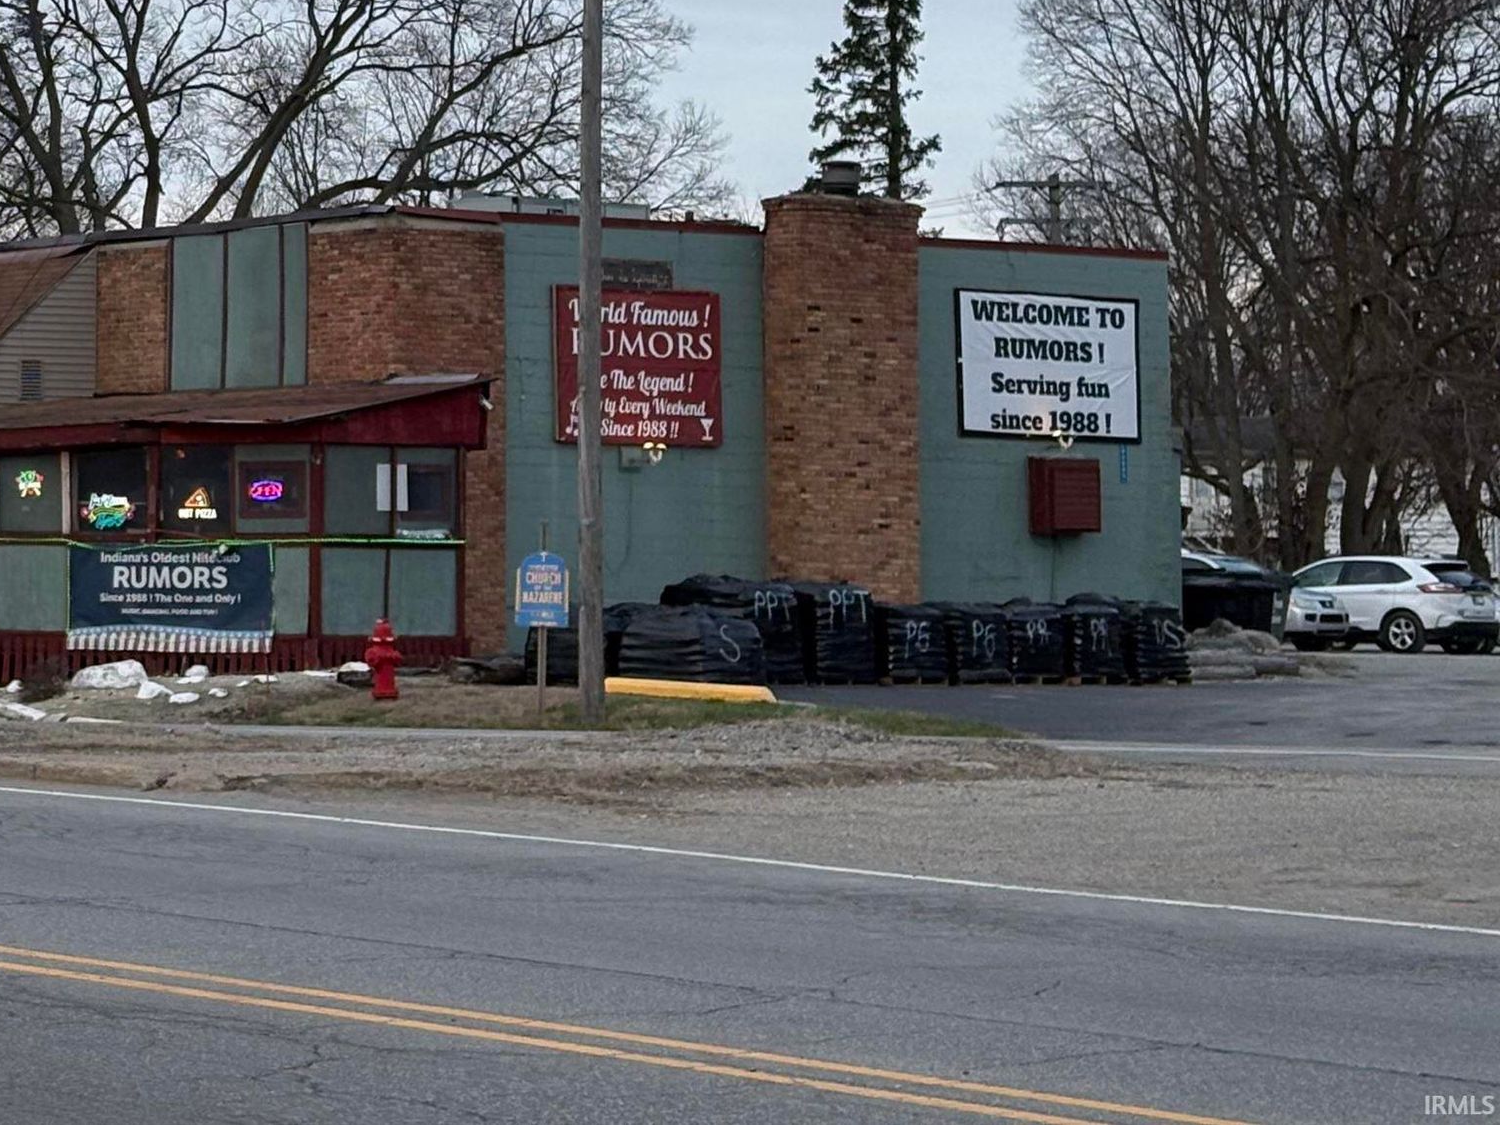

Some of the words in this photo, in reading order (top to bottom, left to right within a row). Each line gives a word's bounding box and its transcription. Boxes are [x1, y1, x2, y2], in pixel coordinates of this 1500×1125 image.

[630, 301, 699, 328] Famous
[971, 299, 1090, 328] WELCOME
[1096, 307, 1125, 329] TO
[571, 327, 713, 360] UMORS
[994, 337, 1093, 363] RUMORS
[1098, 342, 1105, 364] !
[610, 369, 635, 390] The
[637, 370, 685, 397] Legend
[991, 372, 1071, 402] Serving
[1076, 376, 1111, 399] fun
[618, 396, 650, 419] Every
[652, 398, 706, 417] Weekend
[990, 408, 1044, 431] since
[1049, 411, 1100, 433] 1988
[1105, 413, 1112, 434] !
[600, 418, 635, 437] Since
[637, 419, 668, 438] 1988
[100, 551, 149, 564] Indiana's
[151, 552, 190, 564] Oldest
[112, 565, 228, 589] RUMORS
[100, 592, 124, 603] Since
[155, 593, 172, 603] The
[174, 593, 194, 603] One
[195, 593, 213, 603] and
[214, 593, 236, 606] Only
[719, 624, 741, 663] S
